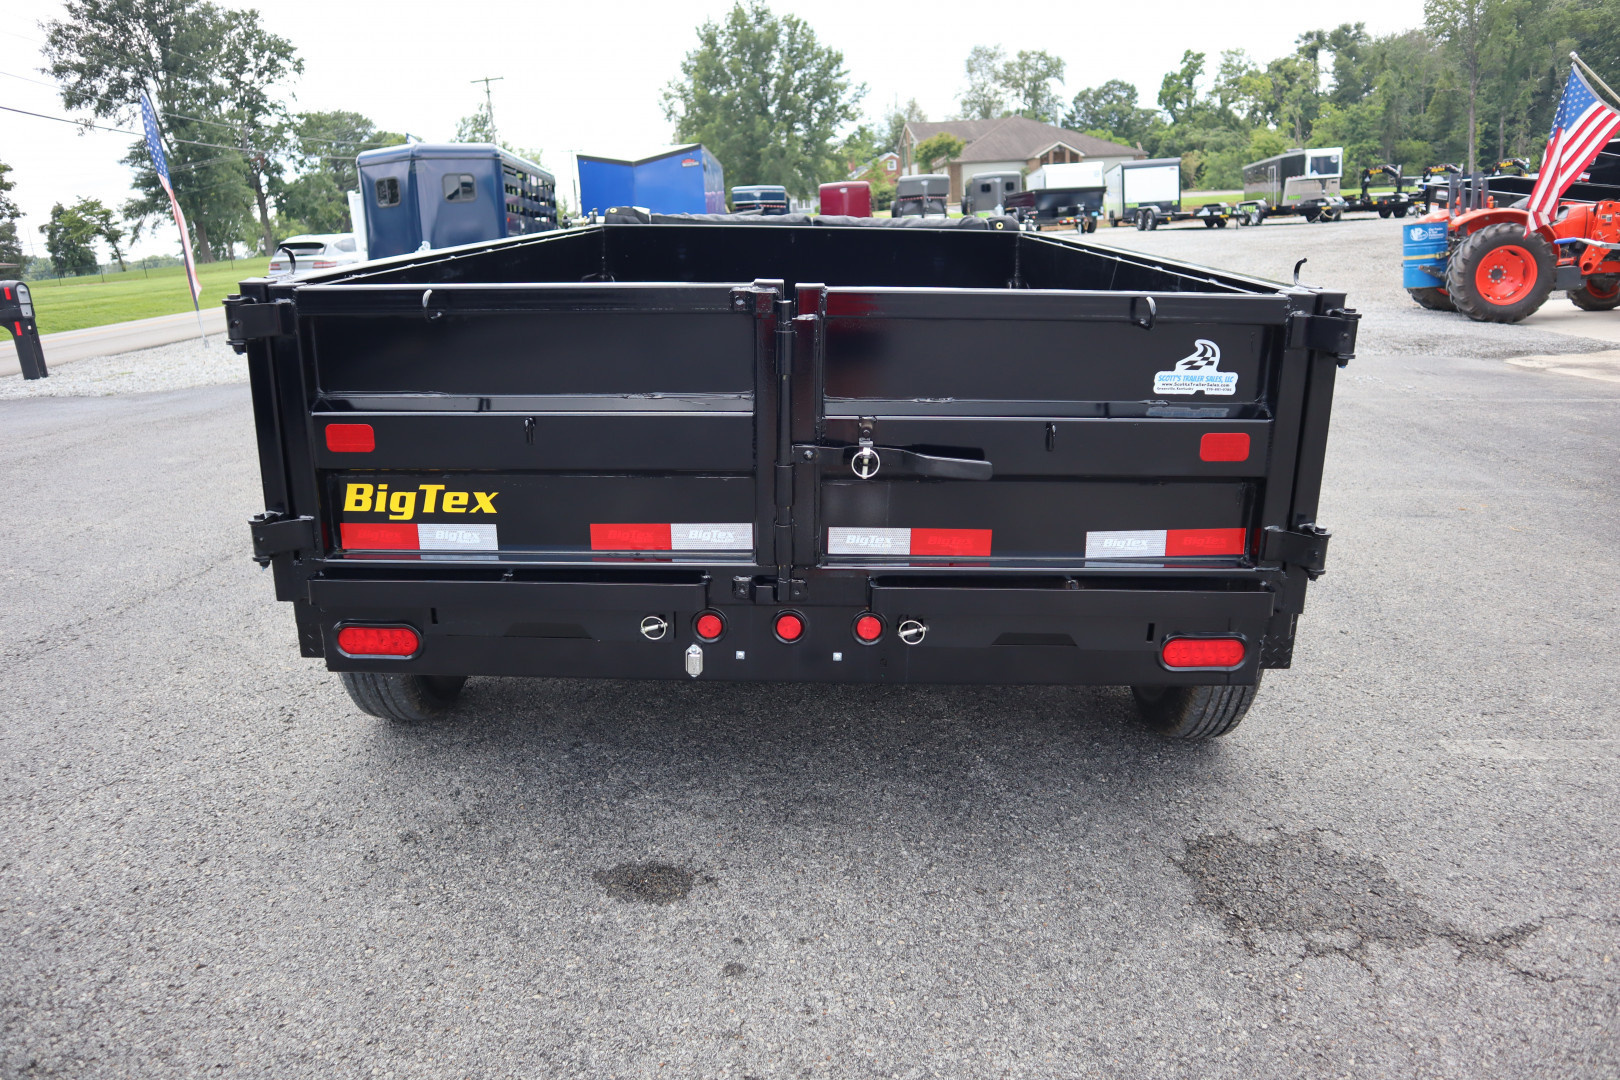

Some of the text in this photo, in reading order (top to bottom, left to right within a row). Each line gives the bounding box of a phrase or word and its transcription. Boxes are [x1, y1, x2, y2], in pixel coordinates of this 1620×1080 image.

[1205, 375, 1223, 383] SALES,
[343, 483, 500, 521] BigTex
[435, 530, 481, 542] BigTex
[688, 529, 735, 542] BigTex
[846, 534, 892, 546] BigTex
[1103, 538, 1148, 549] BigTex
